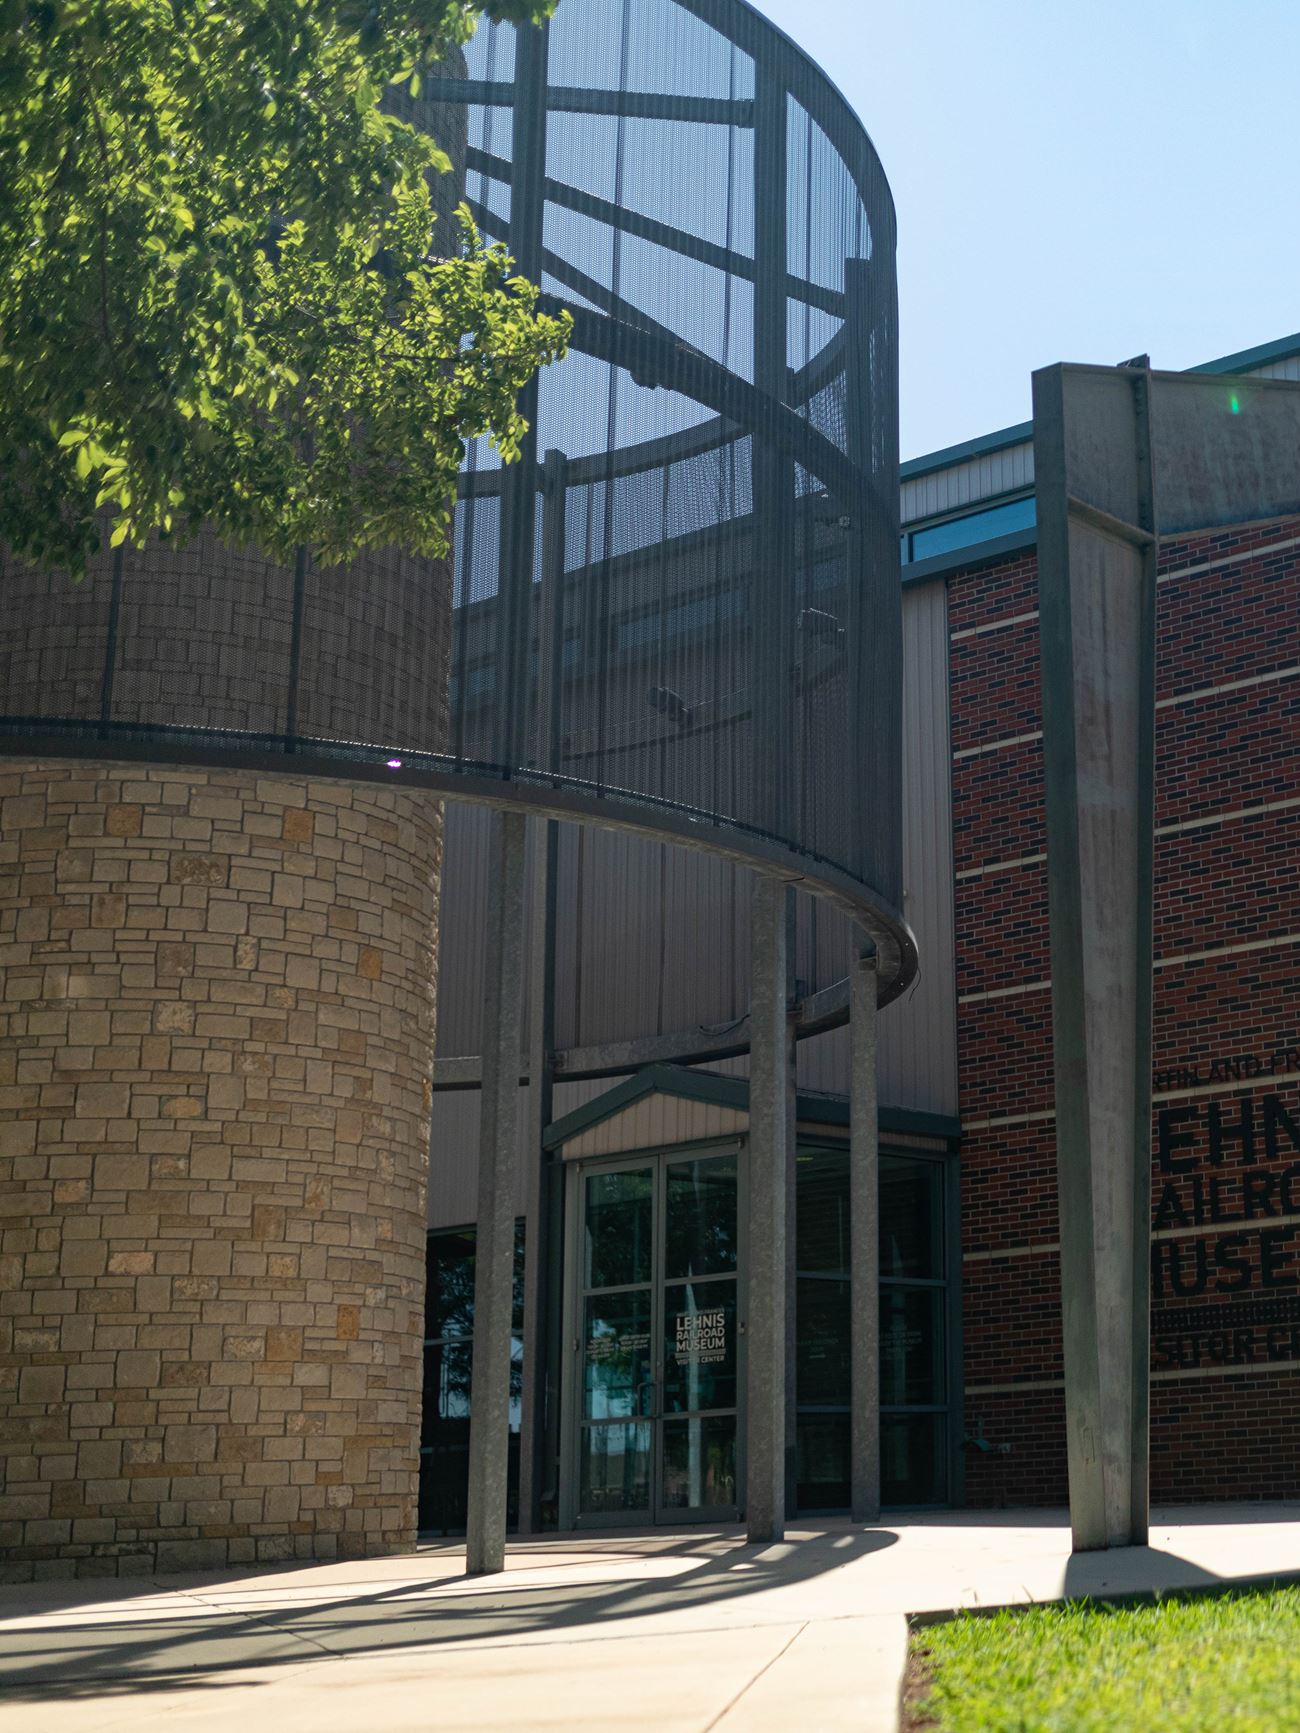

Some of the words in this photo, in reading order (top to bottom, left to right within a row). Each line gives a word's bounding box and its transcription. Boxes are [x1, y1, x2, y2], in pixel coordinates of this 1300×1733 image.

[1209, 1055, 1260, 1083] AND
[676, 1313, 725, 1331] LEHNIS
[676, 1327, 725, 1340] RAILROAD
[676, 1337, 725, 1352] MUSEUM
[701, 1355, 725, 1363] CENTER
